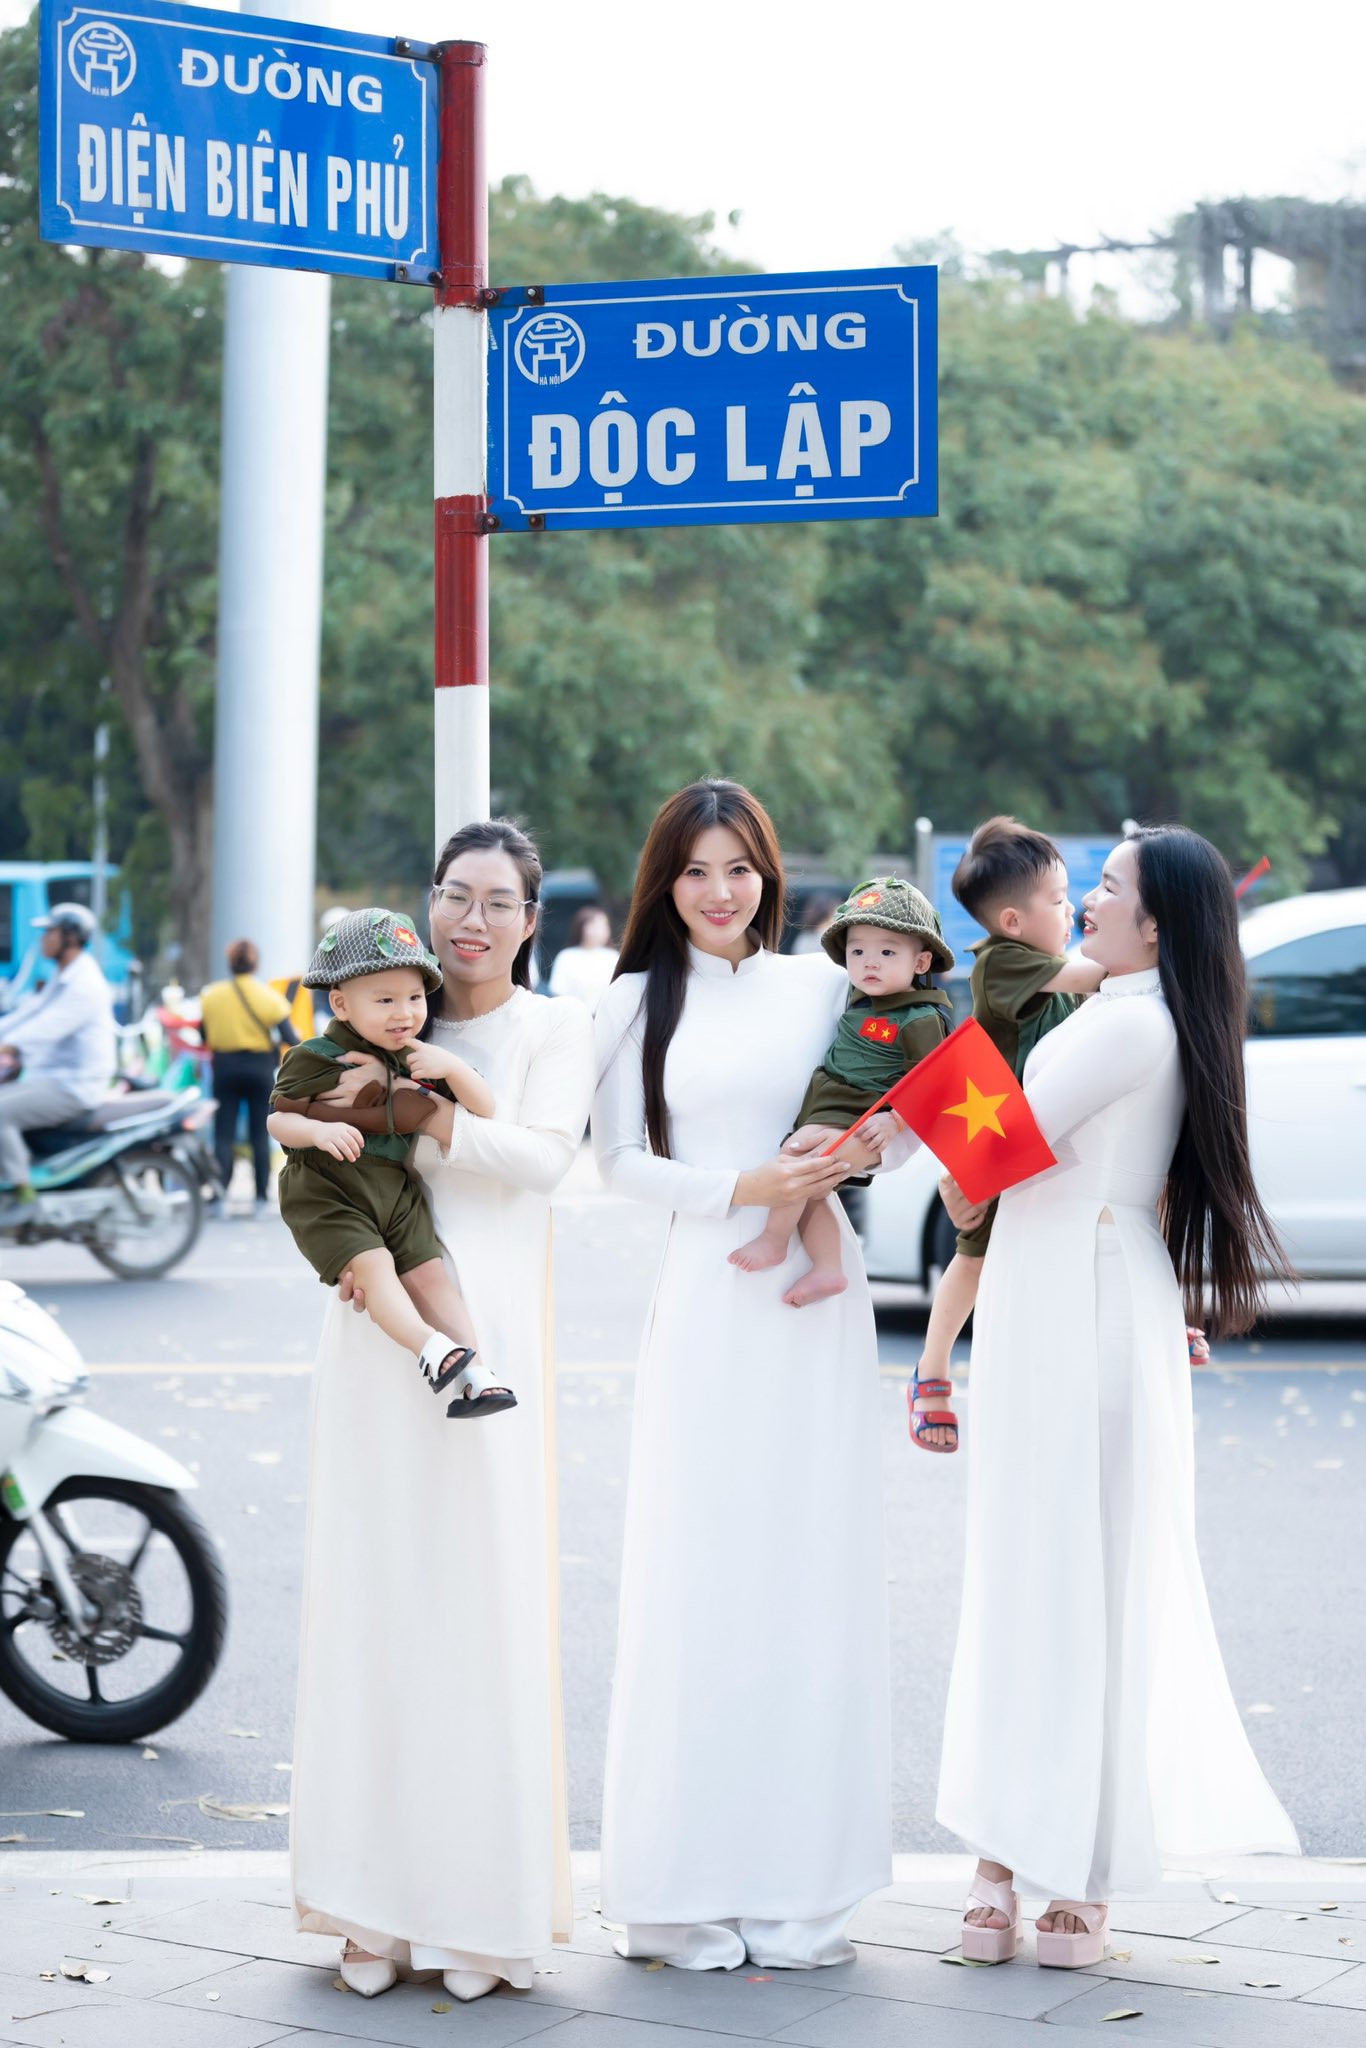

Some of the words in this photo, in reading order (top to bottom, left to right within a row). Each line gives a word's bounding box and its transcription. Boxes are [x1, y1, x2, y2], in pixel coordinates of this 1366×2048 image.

[178, 48, 383, 114] ĐƯỜNG
[77, 112, 187, 225] ĐIỆN
[206, 129, 308, 229] BIÊN
[327, 133, 410, 241] PHỦ
[632, 303, 868, 360] ĐƯỜNG
[528, 390, 697, 505] ĐỘC
[726, 381, 892, 497] LẬP
